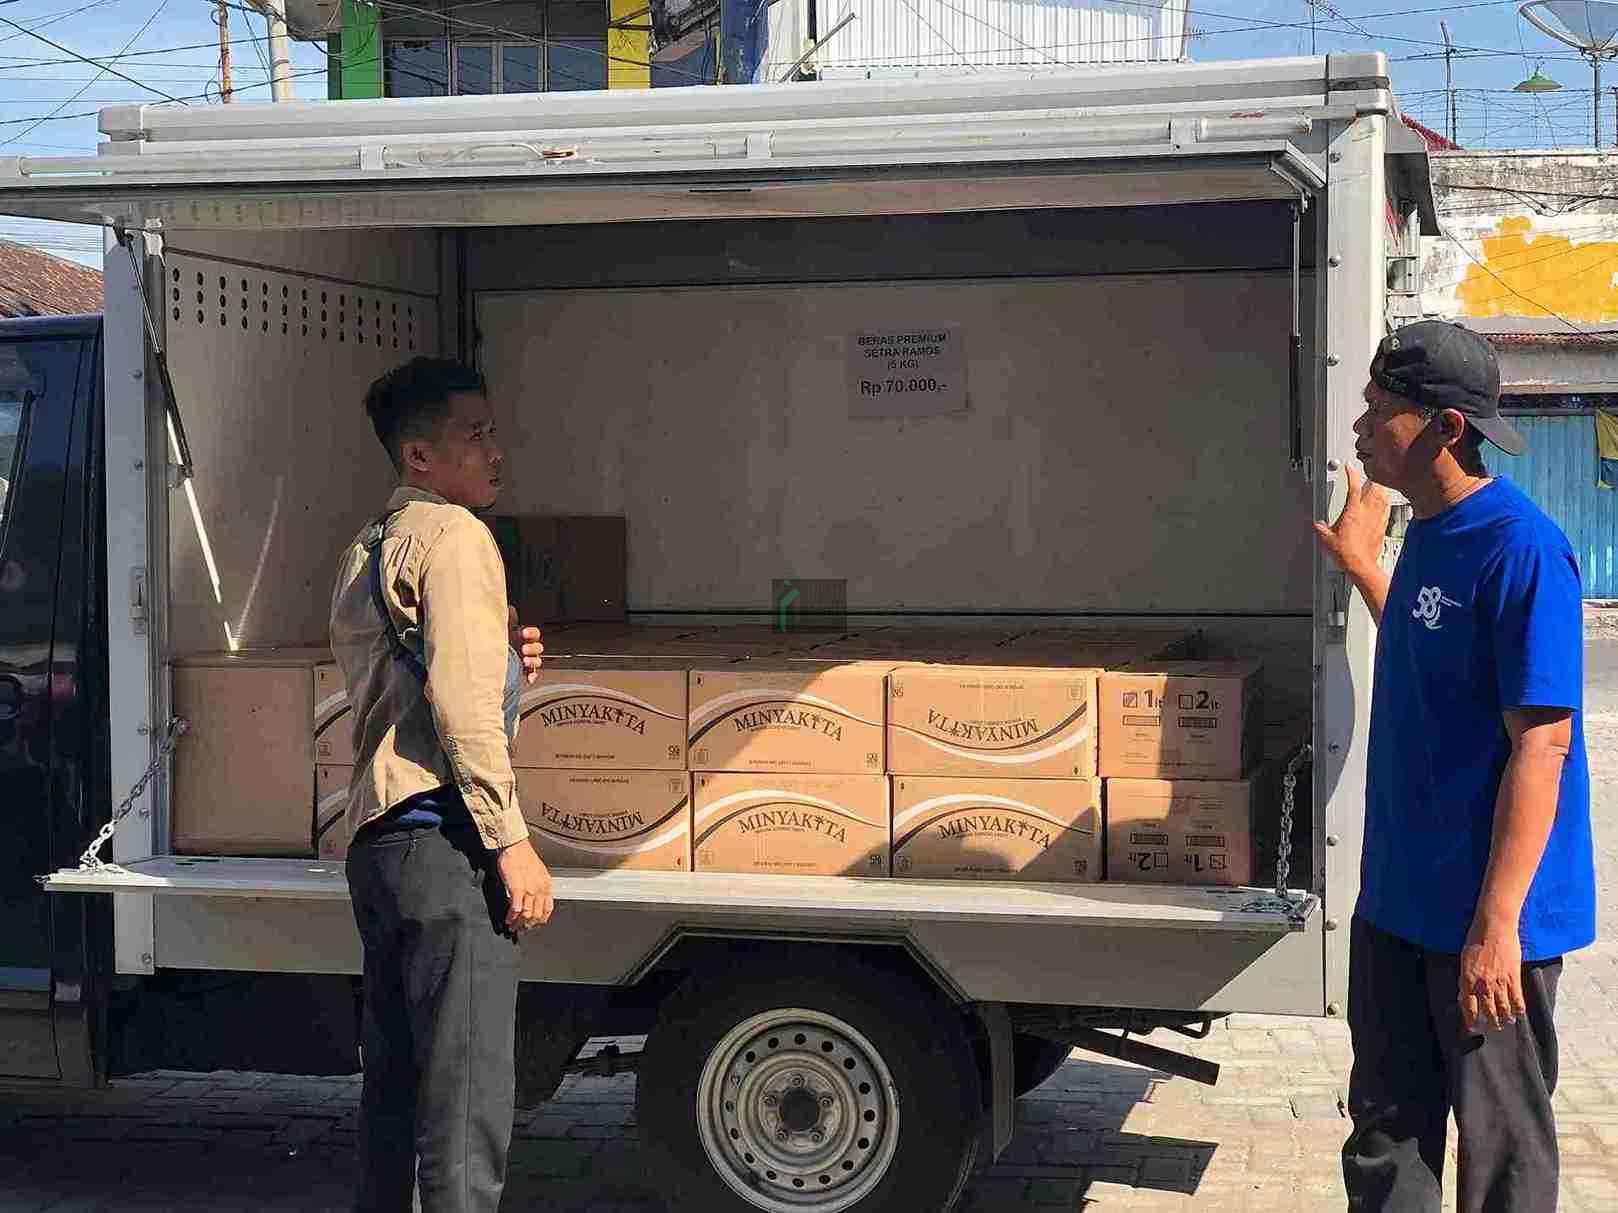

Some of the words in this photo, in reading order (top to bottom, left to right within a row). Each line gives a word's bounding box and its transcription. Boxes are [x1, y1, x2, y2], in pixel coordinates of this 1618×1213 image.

[857, 335, 894, 346] BERAS
[896, 333, 947, 344] PREMIUM
[864, 347, 900, 359] SETRA
[902, 345, 941, 357] RAMOS
[860, 380, 881, 397] Rp
[884, 378, 949, 394] 70.000,-
[540, 703, 647, 736] MINYAKITA
[733, 708, 843, 742] MINYAKITA
[927, 708, 1040, 743] MINYAKITA
[541, 801, 645, 834] MINYAKITA
[738, 809, 848, 843] MINYAKITA
[937, 815, 1051, 849] MINYAKITA
